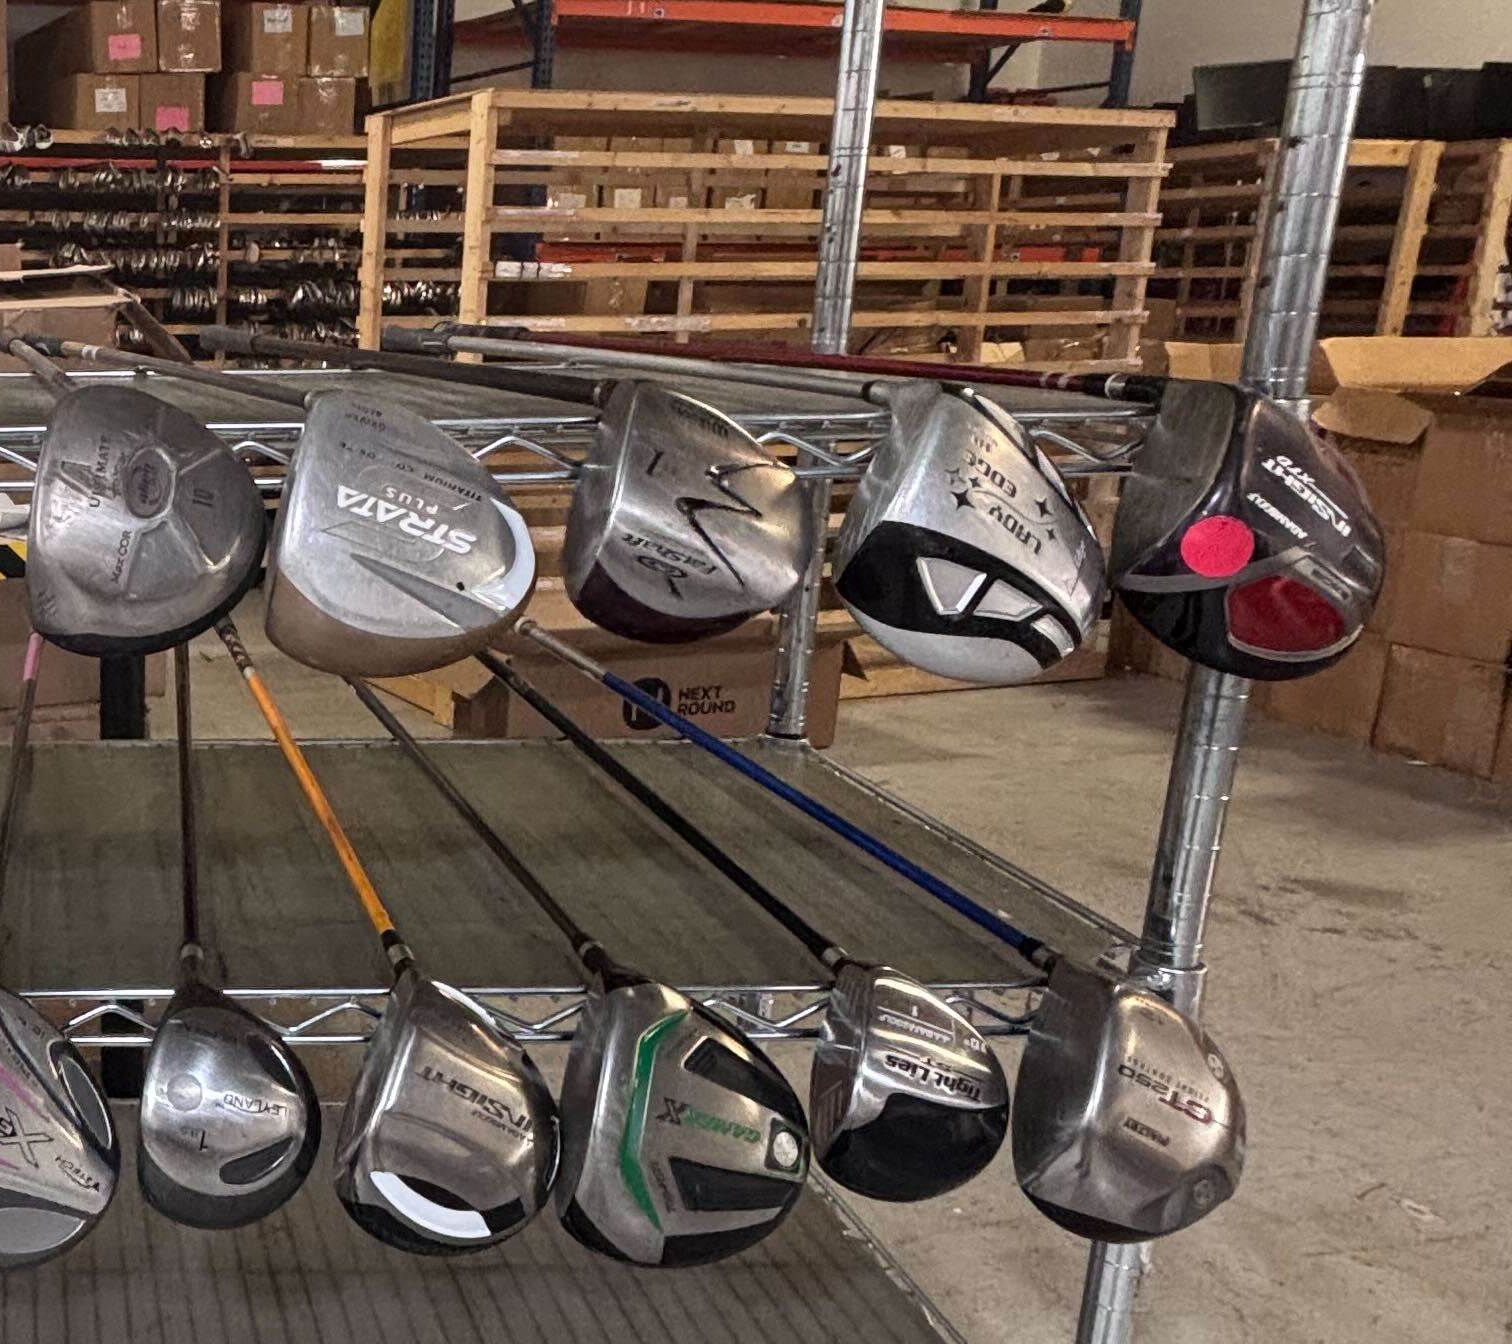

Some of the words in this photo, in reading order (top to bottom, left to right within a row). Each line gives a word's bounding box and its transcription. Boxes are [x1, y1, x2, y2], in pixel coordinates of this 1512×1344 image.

[965, 449, 1017, 498] EDGE
[1274, 454, 1315, 486] XTD
[191, 487, 216, 509] 10
[383, 485, 439, 516] PLUS
[422, 472, 483, 503] TITANIUM
[1262, 457, 1352, 537] INSIGHT
[335, 485, 478, 555] STRATA
[989, 504, 1043, 554] LADY
[678, 701, 735, 716] ROUND
[679, 686, 722, 701] NEXT
[883, 1053, 930, 1083] Lies
[416, 1064, 535, 1131] INSIGHT
[930, 1071, 983, 1102] Tight
[1116, 1063, 1215, 1126] GT250
[222, 1094, 288, 1116] LEYLAND
[198, 1130, 210, 1152] 1
